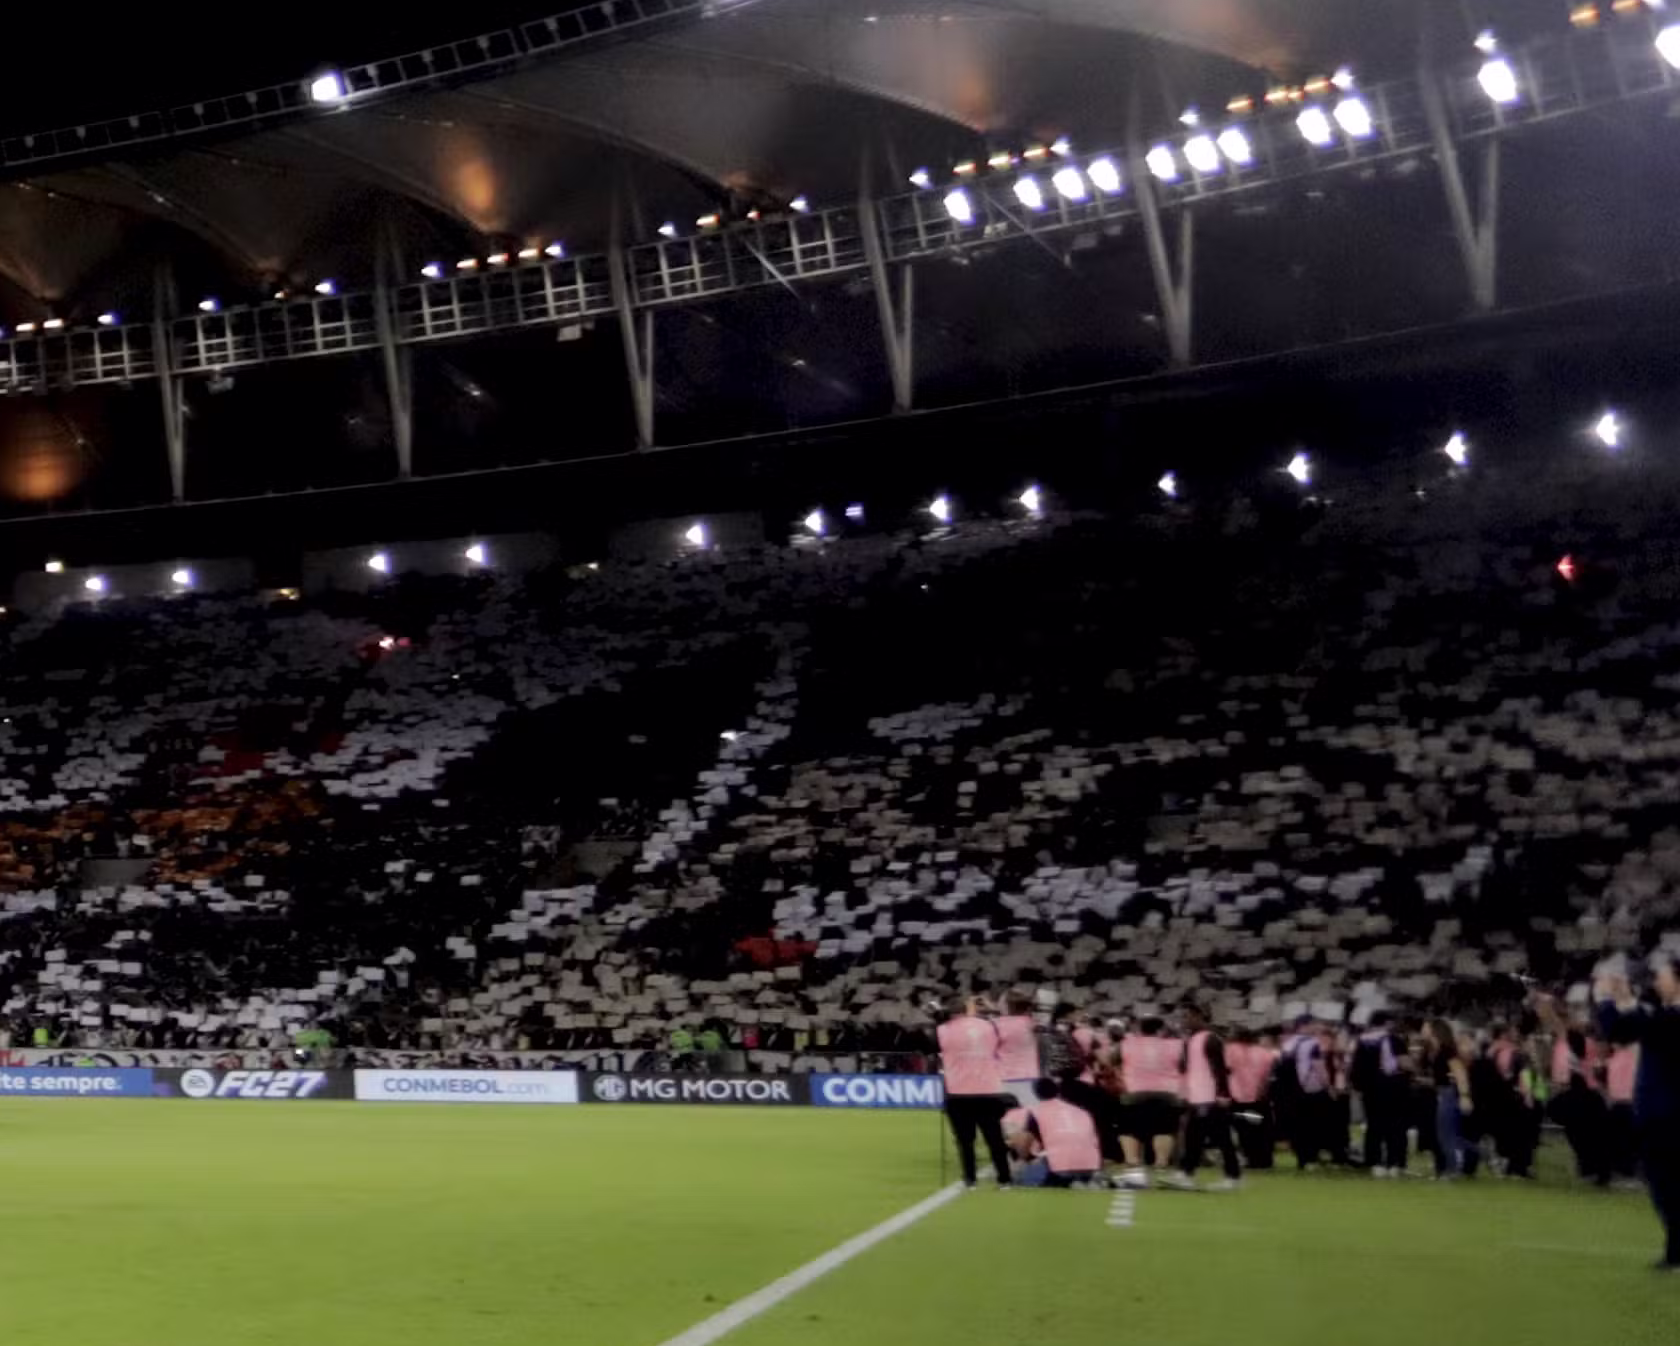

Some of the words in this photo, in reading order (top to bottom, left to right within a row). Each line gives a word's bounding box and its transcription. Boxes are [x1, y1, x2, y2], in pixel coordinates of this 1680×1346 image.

[384, 1077, 549, 1095] CONMEBOL.com
[631, 1078, 675, 1099] MG
[683, 1079, 791, 1101] MOTOR
